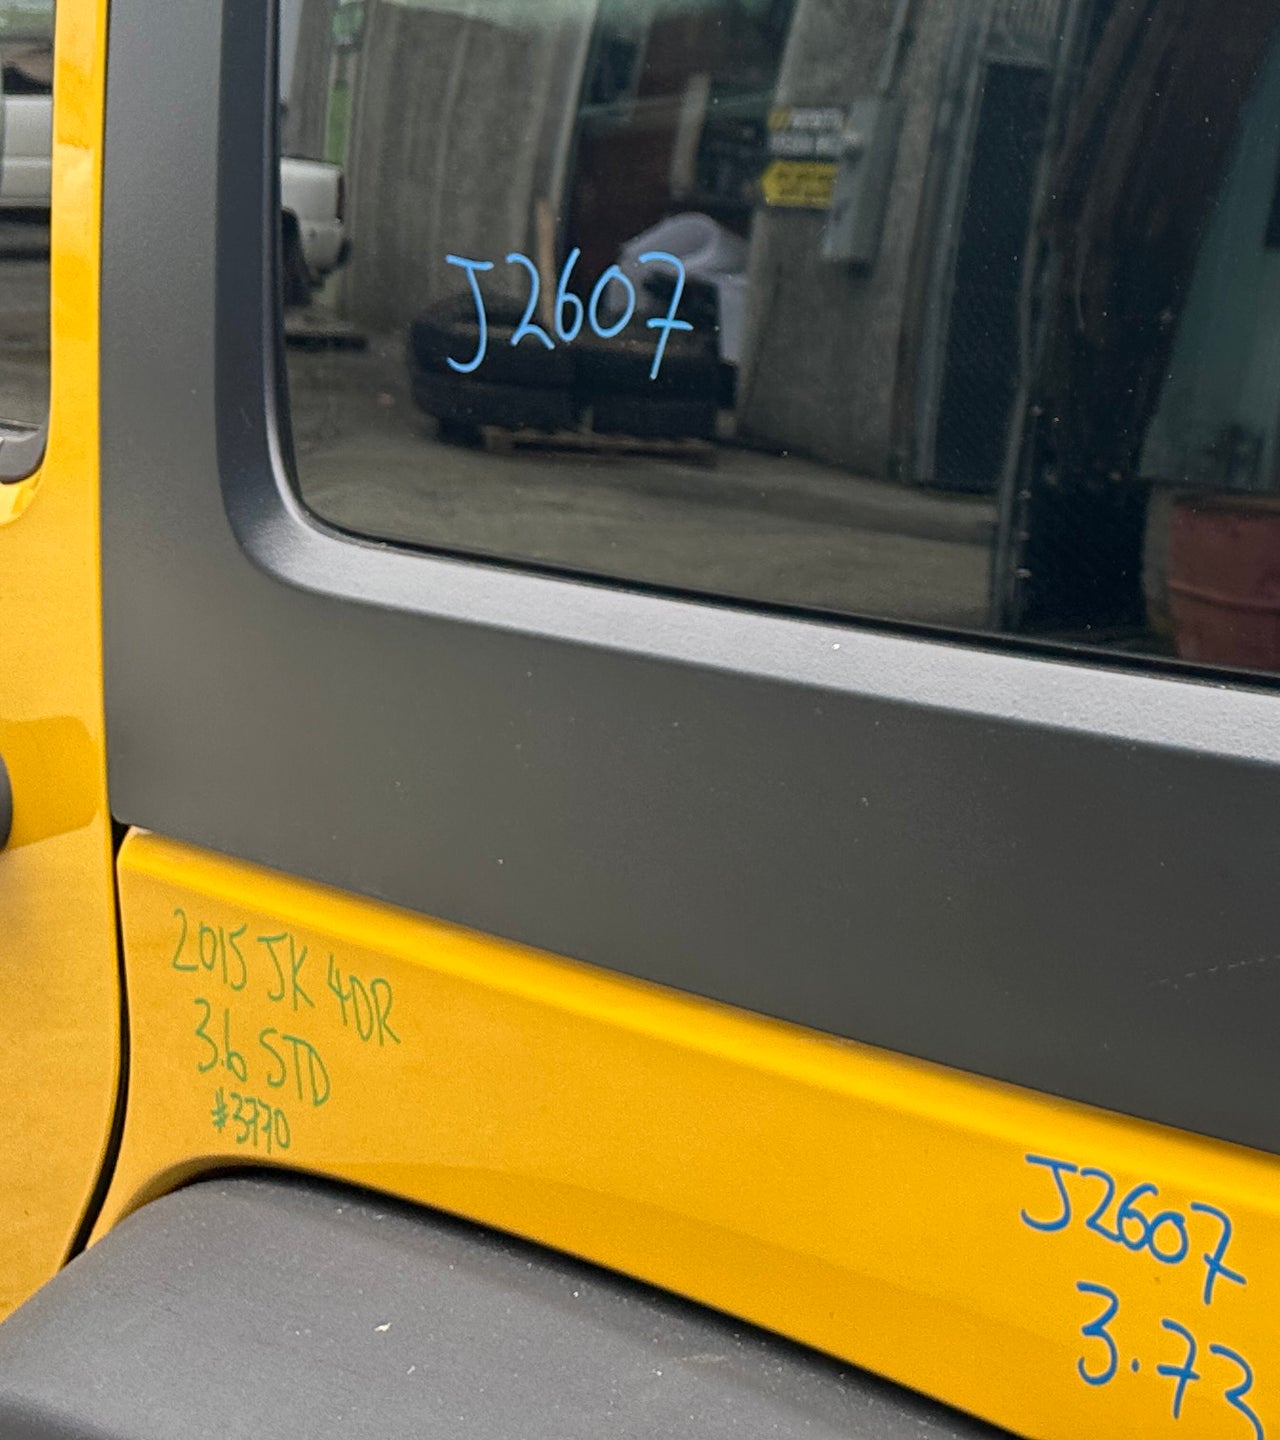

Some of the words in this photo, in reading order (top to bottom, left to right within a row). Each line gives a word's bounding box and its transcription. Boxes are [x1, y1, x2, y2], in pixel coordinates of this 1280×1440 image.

[445, 247, 694, 381] J2607
[171, 908, 248, 991] 2015
[257, 932, 316, 1011] JK
[258, 1027, 331, 1107] STD
[1020, 1153, 1248, 1306] J2607
[1076, 1279, 1266, 1440] 3.73
